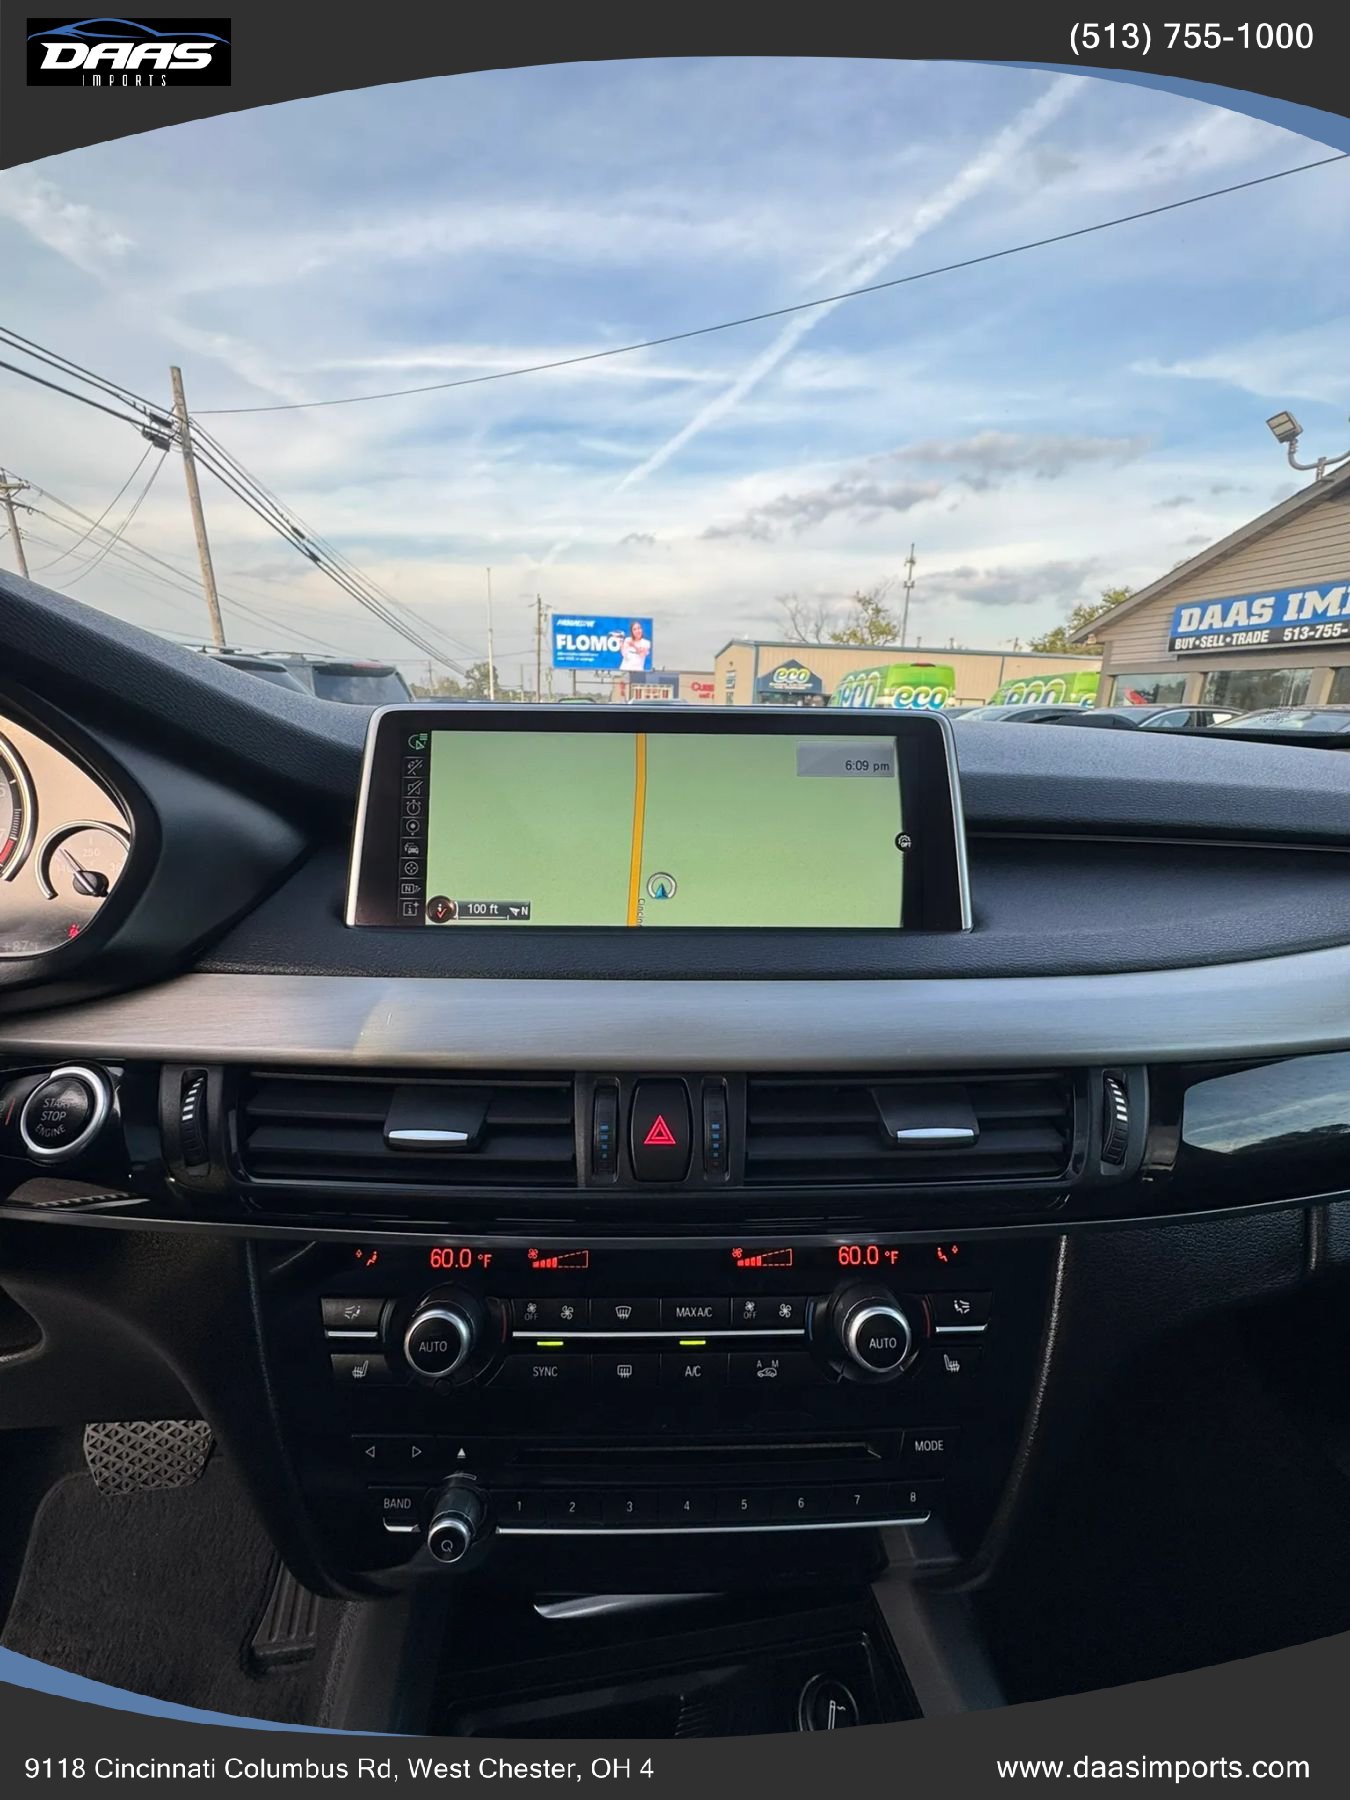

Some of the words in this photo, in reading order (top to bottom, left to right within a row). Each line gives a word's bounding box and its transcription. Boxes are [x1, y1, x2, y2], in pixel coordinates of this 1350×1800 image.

[1177, 597, 1276, 632] DAAS
[1174, 637, 1196, 650] BUY
[1200, 634, 1225, 648] SELL
[1231, 630, 1270, 645] TRADE
[773, 667, 811, 683] eco
[892, 685, 949, 710] eco
[845, 760, 869, 771] 6:09
[873, 764, 890, 772] pm
[467, 903, 487, 914] 100
[489, 903, 499, 914] ft
[521, 906, 529, 916] N
[40, 1110, 67, 1121] STOP
[35, 1123, 66, 1137] ENGINE
[430, 1249, 472, 1269] 60.0
[838, 1246, 879, 1266] 60.0
[524, 1313, 539, 1321] OFF
[743, 1311, 757, 1320] OFF
[419, 1340, 448, 1353] AUTO
[869, 1337, 898, 1350] AUTO
[532, 1366, 558, 1378] SYNC
[684, 1366, 702, 1378] A/C
[915, 1440, 944, 1452] MODE
[383, 1498, 412, 1510] BAND
[516, 1501, 523, 1511] 1
[569, 1502, 576, 1512] 2
[626, 1502, 634, 1512] 3
[683, 1501, 691, 1511] 4
[741, 1499, 749, 1510] 5
[798, 1498, 806, 1509] 6
[854, 1495, 861, 1505] 7
[909, 1492, 917, 1503] 8
